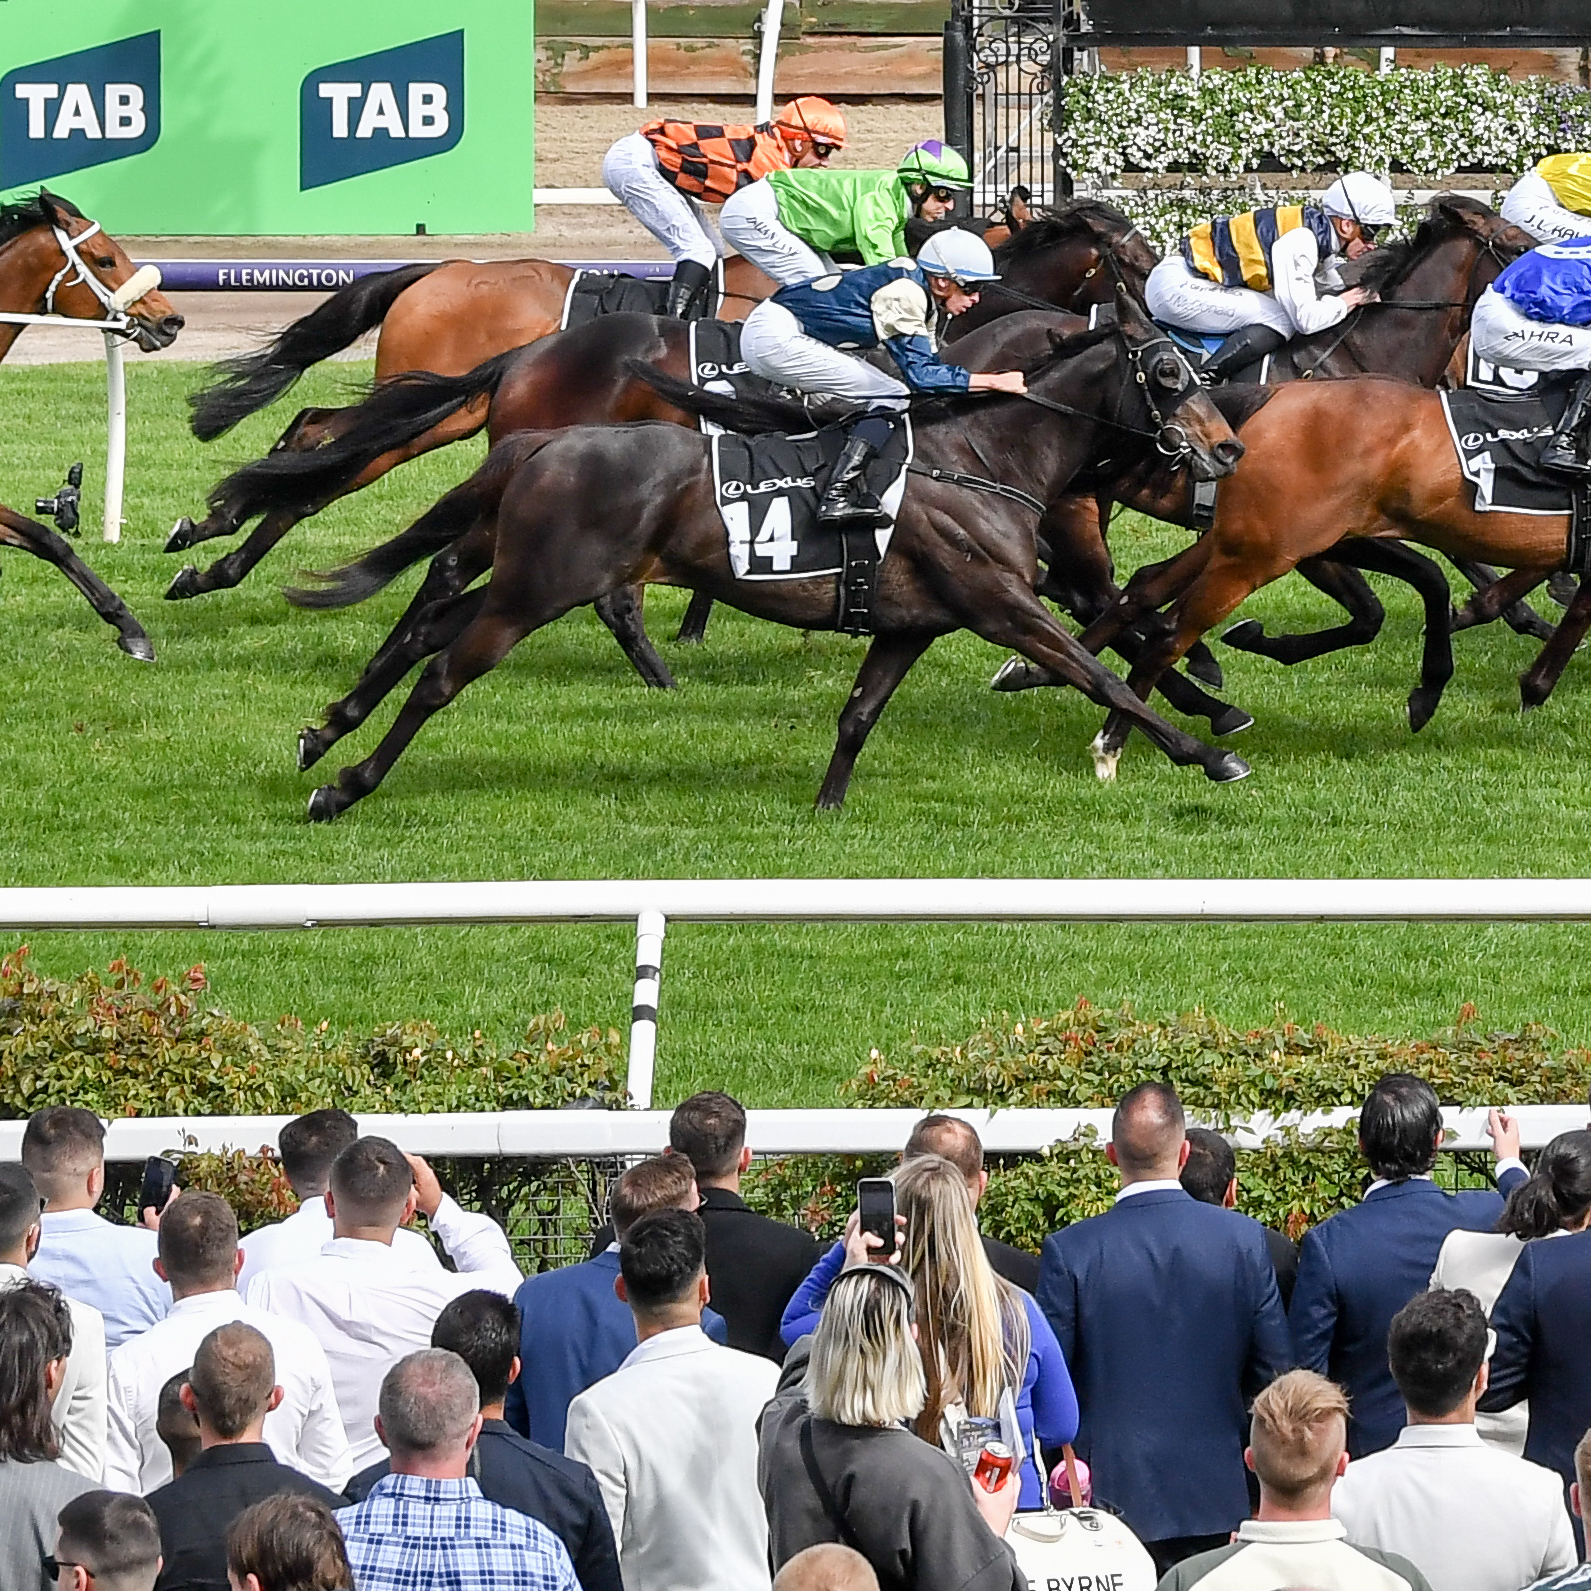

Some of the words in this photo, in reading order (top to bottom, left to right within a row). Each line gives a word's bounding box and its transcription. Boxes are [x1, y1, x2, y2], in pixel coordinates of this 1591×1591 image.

[14, 83, 147, 139] TAB
[318, 82, 450, 139] TAB
[218, 268, 354, 287] FLEMINGTON
[746, 476, 816, 494] LEXUS
[720, 495, 798, 571] 14
